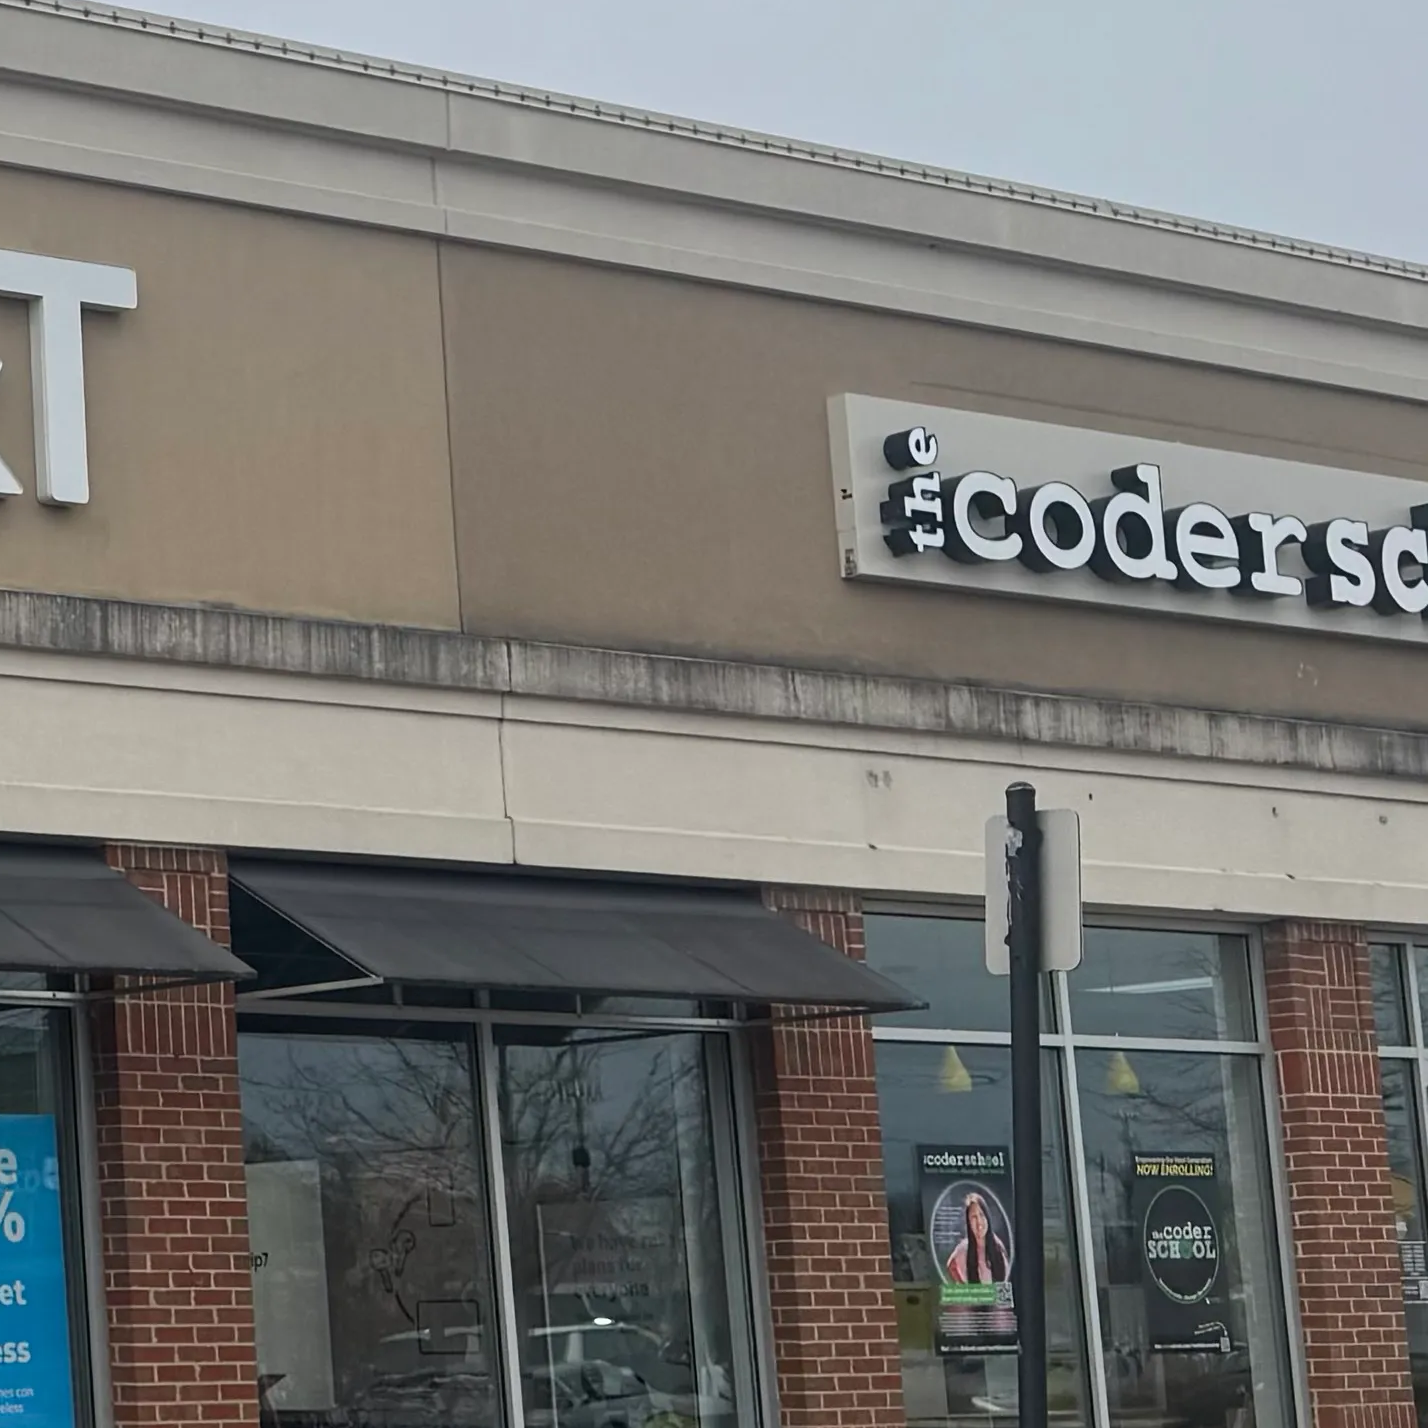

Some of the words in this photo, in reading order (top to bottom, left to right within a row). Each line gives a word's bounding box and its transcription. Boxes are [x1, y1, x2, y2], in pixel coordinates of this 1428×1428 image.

[894, 426, 944, 554] the
[1137, 1164, 1160, 1176] NOW
[1161, 1163, 1213, 1176] ENROLLING!
[1164, 1222, 1212, 1239] coder
[1147, 1239, 1216, 1259] SCHOOL
[16, 1388, 34, 1398] con
